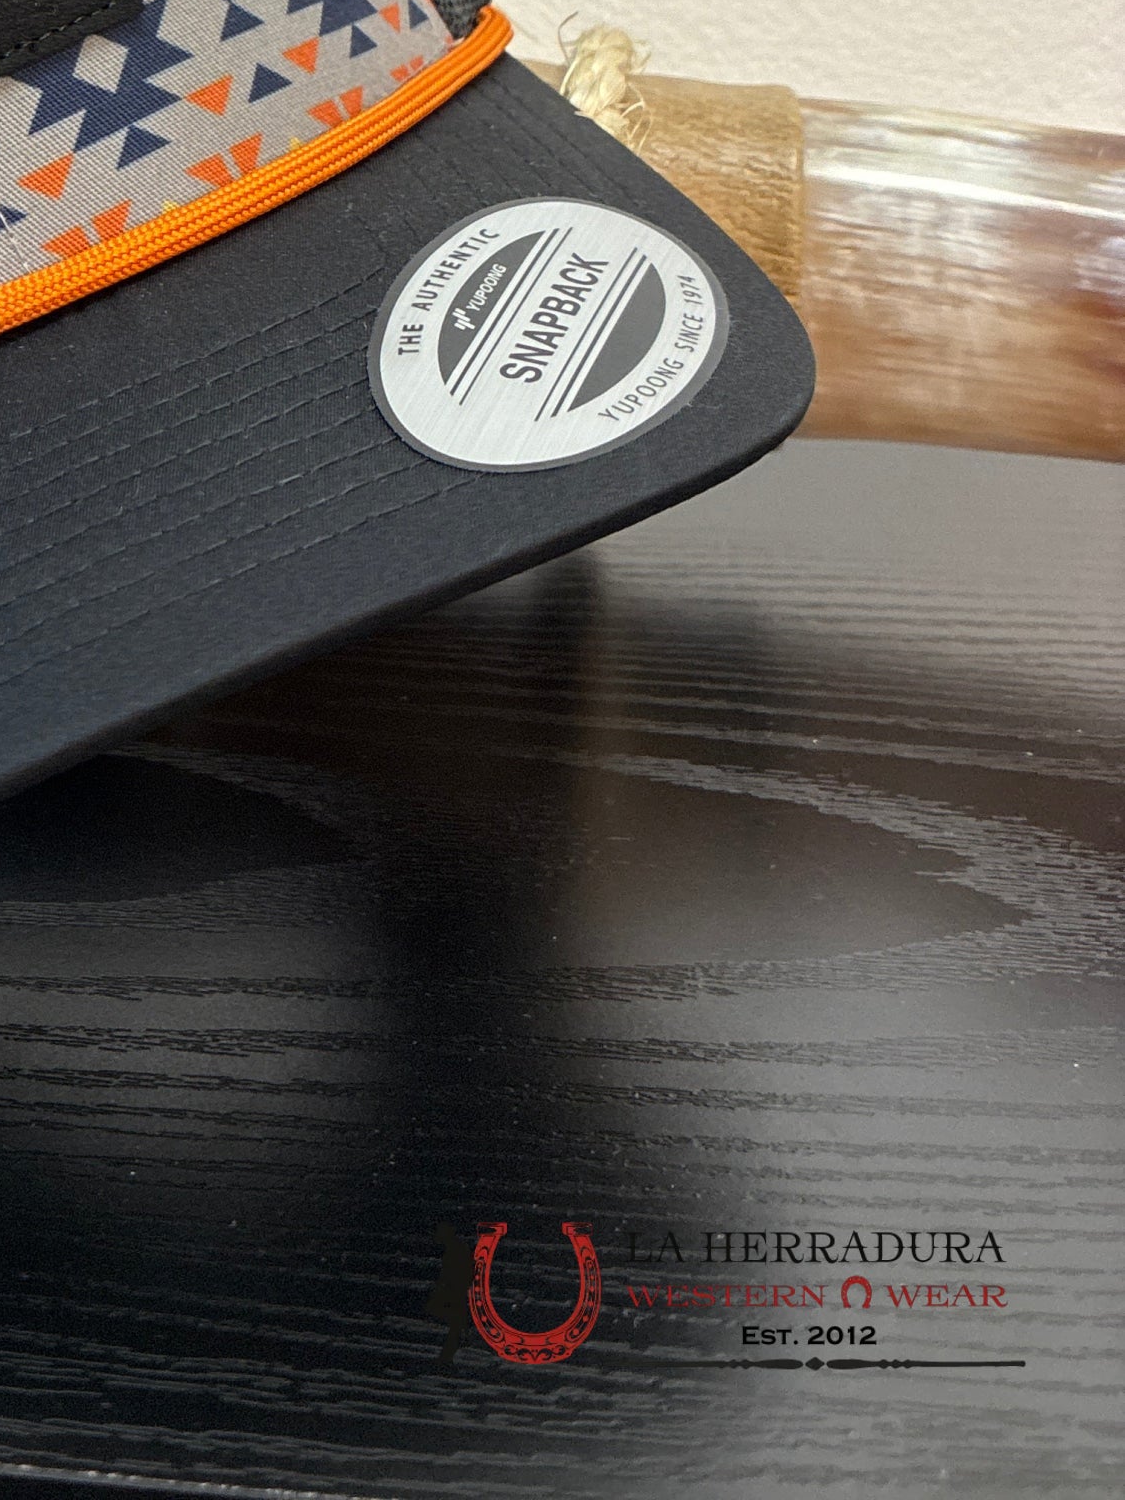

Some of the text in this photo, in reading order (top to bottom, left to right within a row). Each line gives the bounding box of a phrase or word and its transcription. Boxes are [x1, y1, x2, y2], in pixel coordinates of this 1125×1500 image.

[398, 228, 500, 356] THE AUTHENTIC
[466, 263, 507, 312] YUPOONG
[499, 252, 609, 384] SNAPBACK
[598, 275, 704, 422] YUPOONG SINCE 1974
